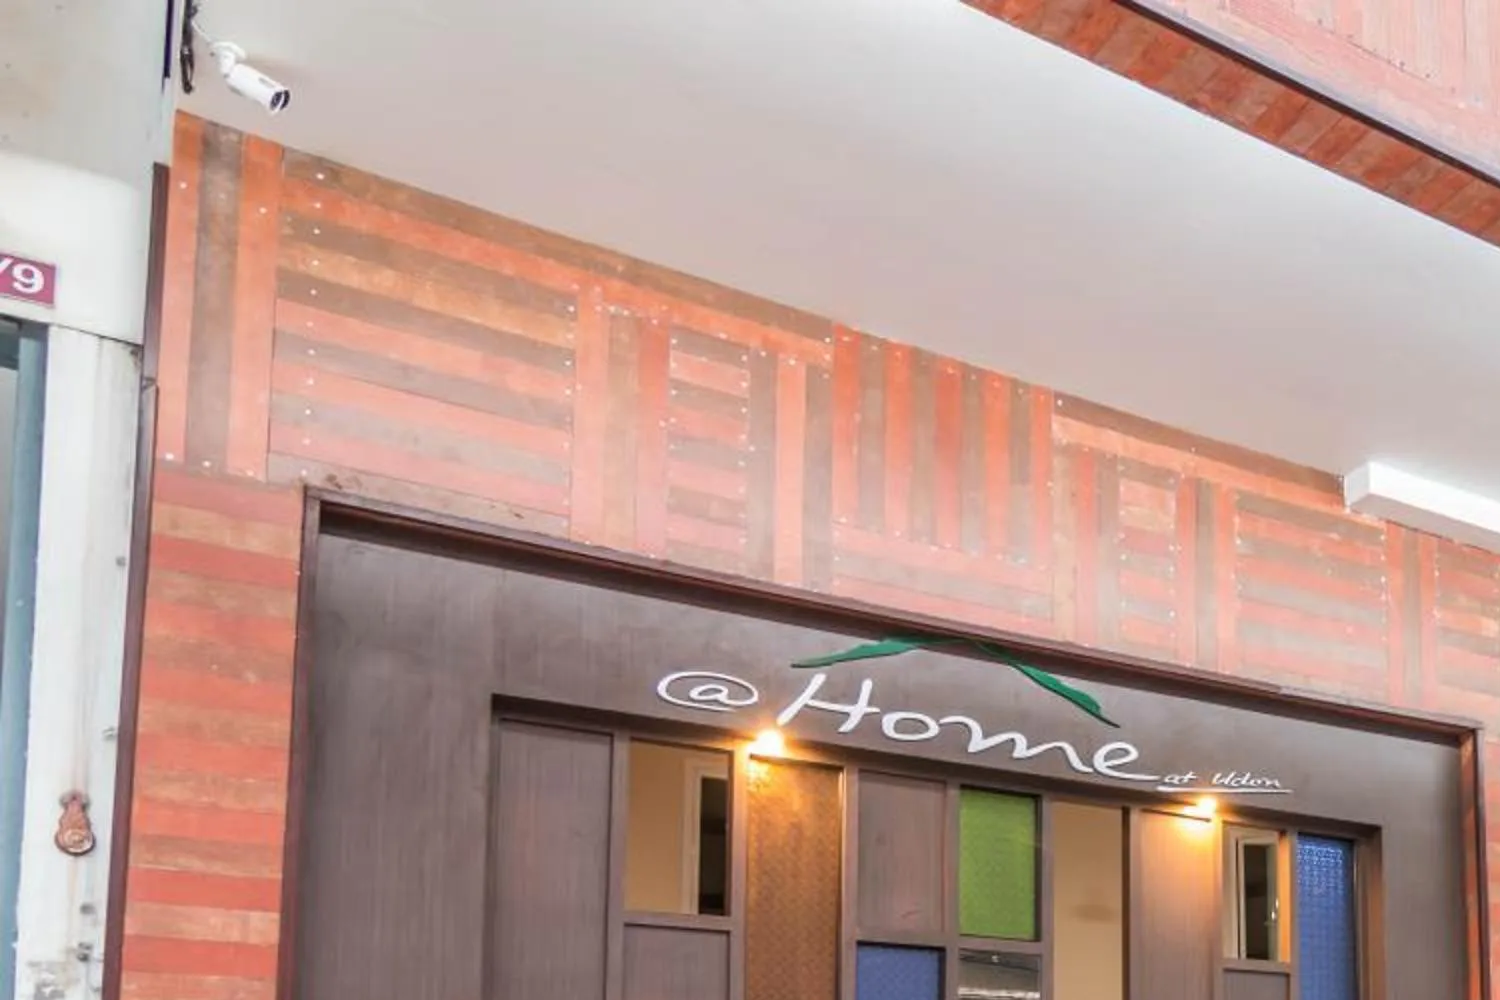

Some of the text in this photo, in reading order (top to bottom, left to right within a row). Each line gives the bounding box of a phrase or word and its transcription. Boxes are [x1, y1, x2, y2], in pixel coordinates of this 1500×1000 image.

[656, 671, 1282, 789] @ Home at Udon
